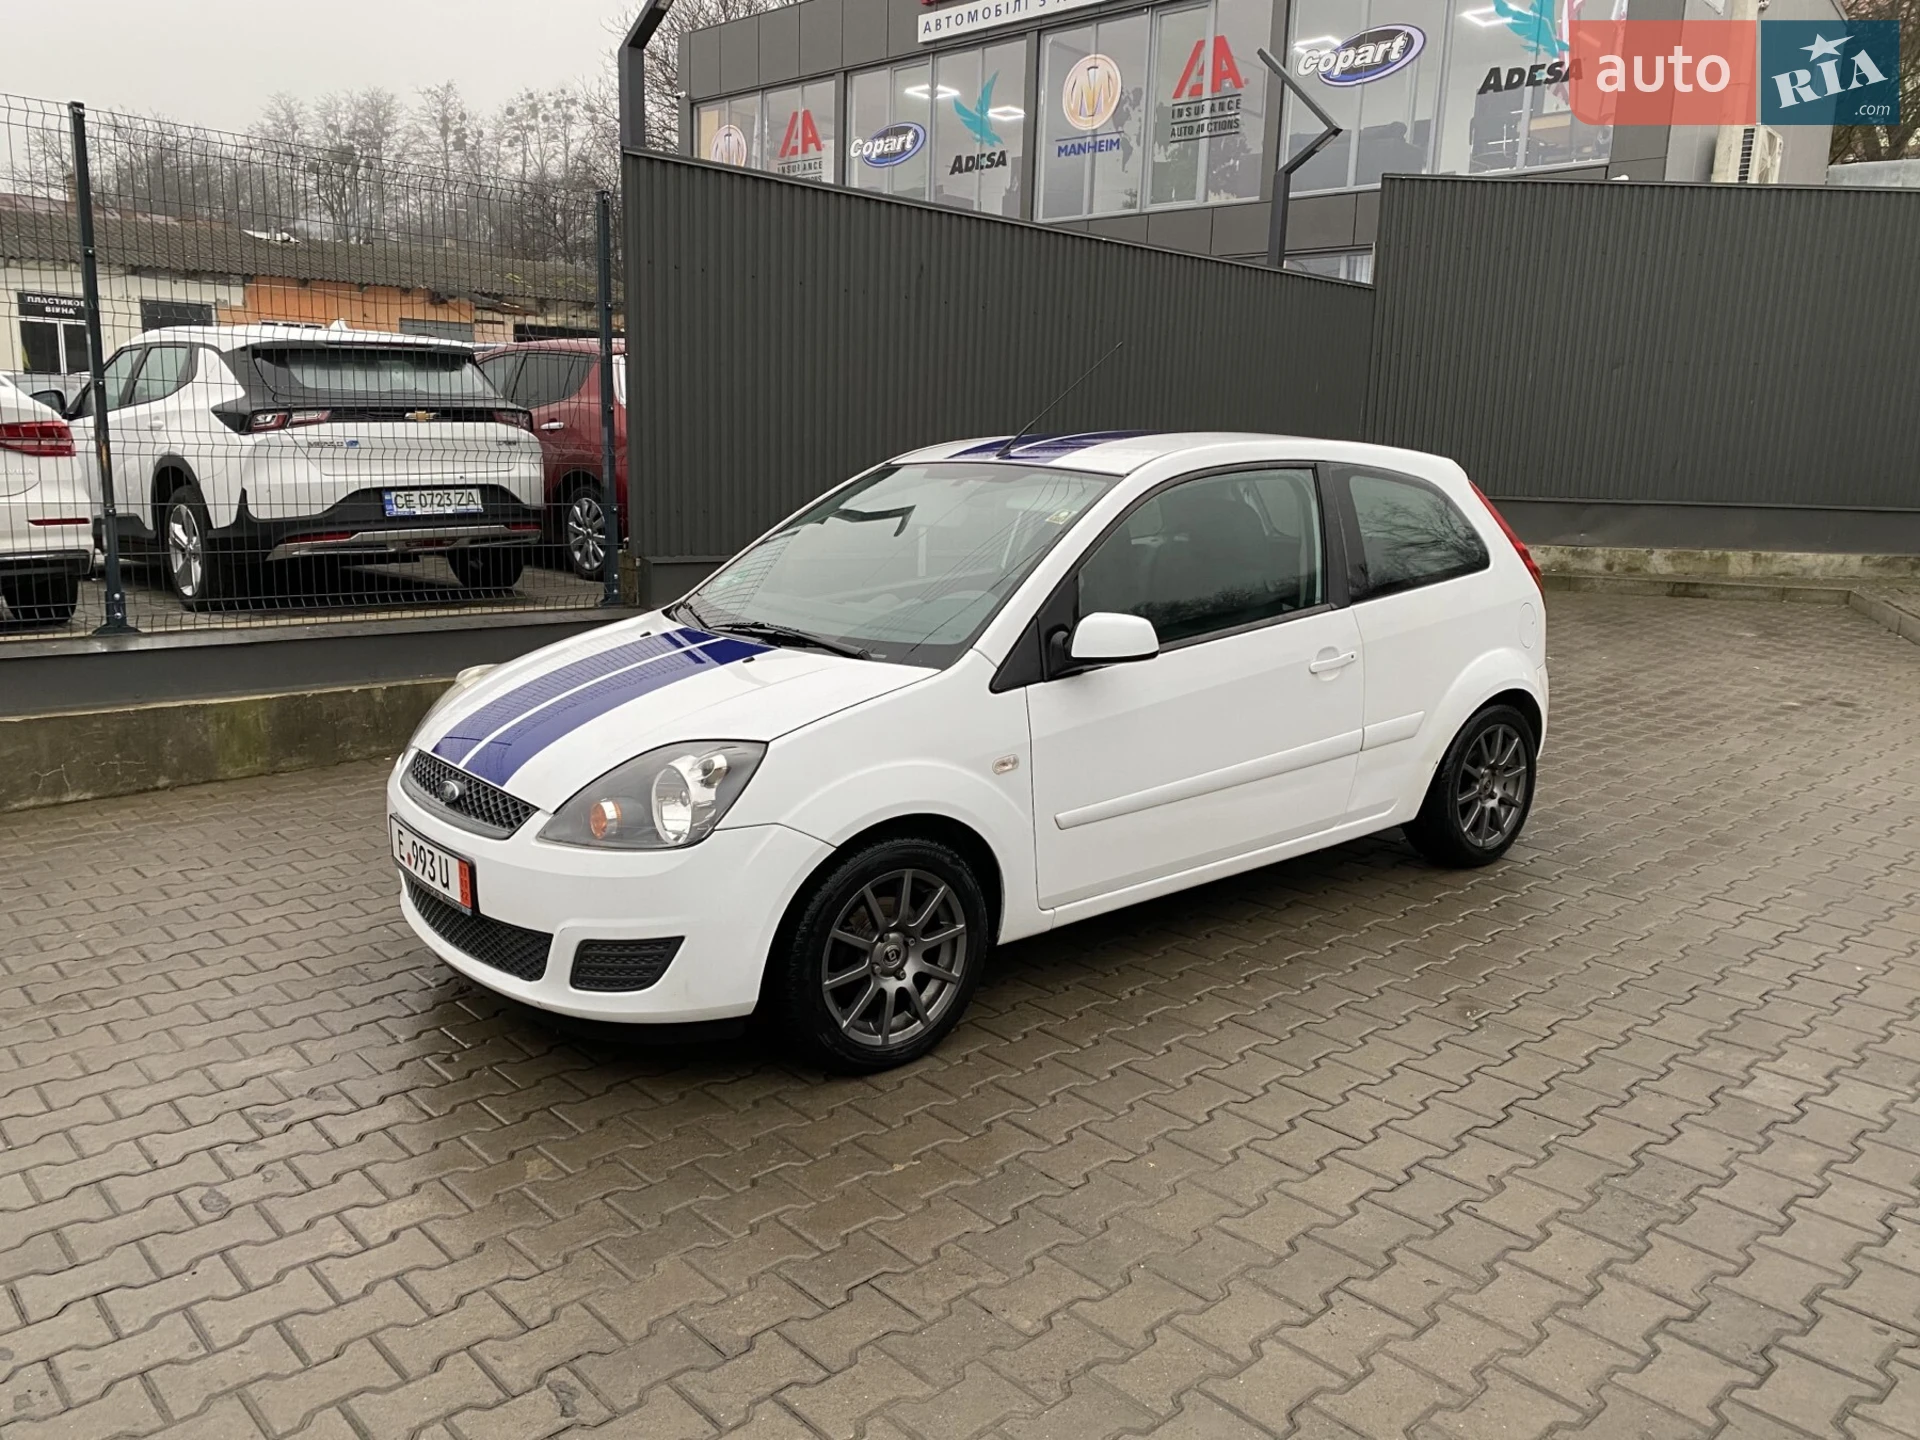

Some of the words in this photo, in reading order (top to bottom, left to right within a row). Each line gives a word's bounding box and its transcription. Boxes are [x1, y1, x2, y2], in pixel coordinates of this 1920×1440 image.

[1297, 31, 1408, 77] Copart
[1477, 58, 1584, 95] ADESA
[849, 127, 915, 159] Copart
[1170, 125, 1194, 138] AUTO
[1057, 138, 1120, 158] MANHEIM
[949, 149, 1007, 176] ADESA
[394, 493, 416, 509] CE
[419, 492, 452, 508] 0723
[455, 491, 477, 506] ZA
